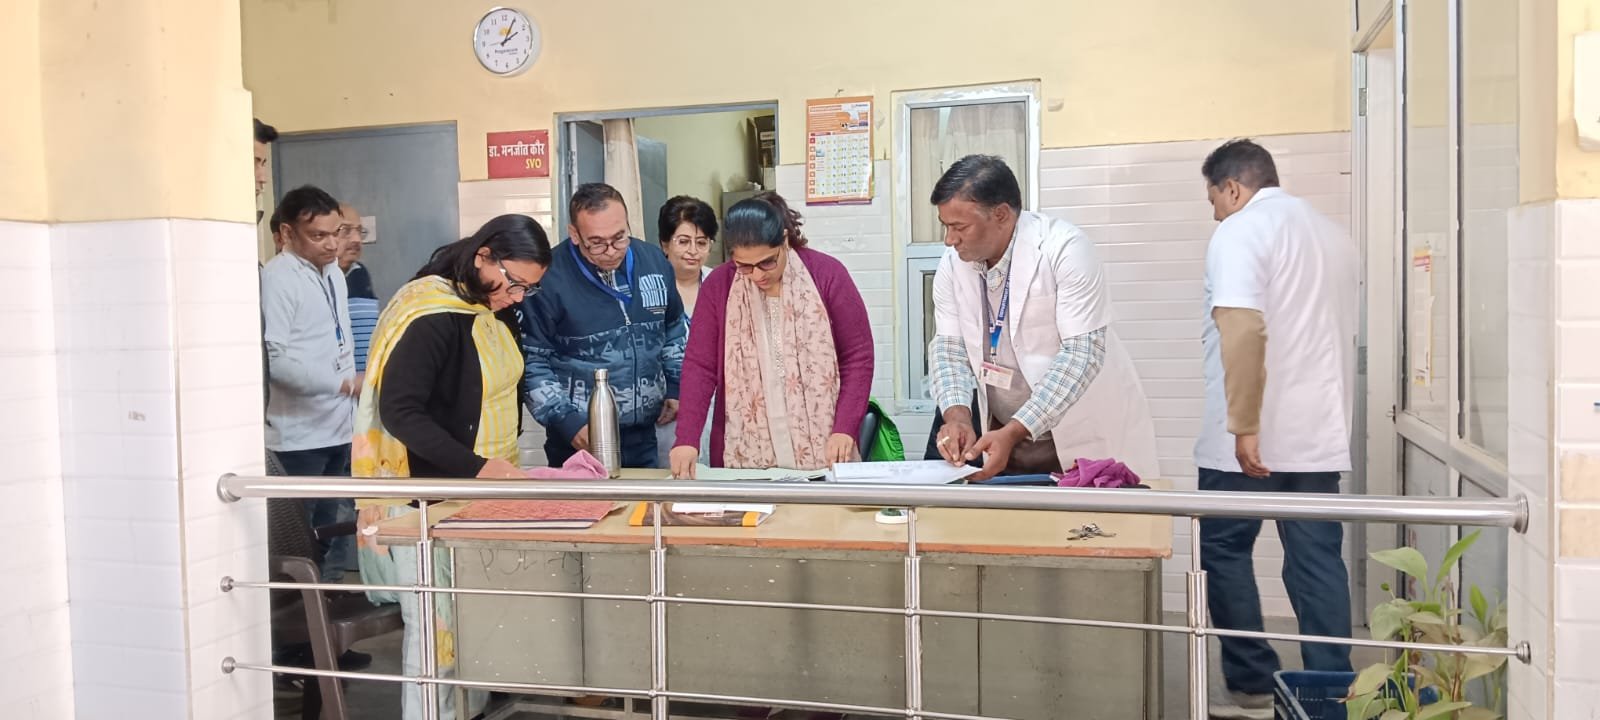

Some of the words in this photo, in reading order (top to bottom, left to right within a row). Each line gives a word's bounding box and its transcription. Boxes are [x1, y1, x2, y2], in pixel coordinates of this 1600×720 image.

[501, 14, 508, 22] 12
[483, 28, 490, 36] 10
[501, 140, 529, 157] मनजीत
[529, 139, 546, 156] कौर
[525, 158, 542, 169] SVO
